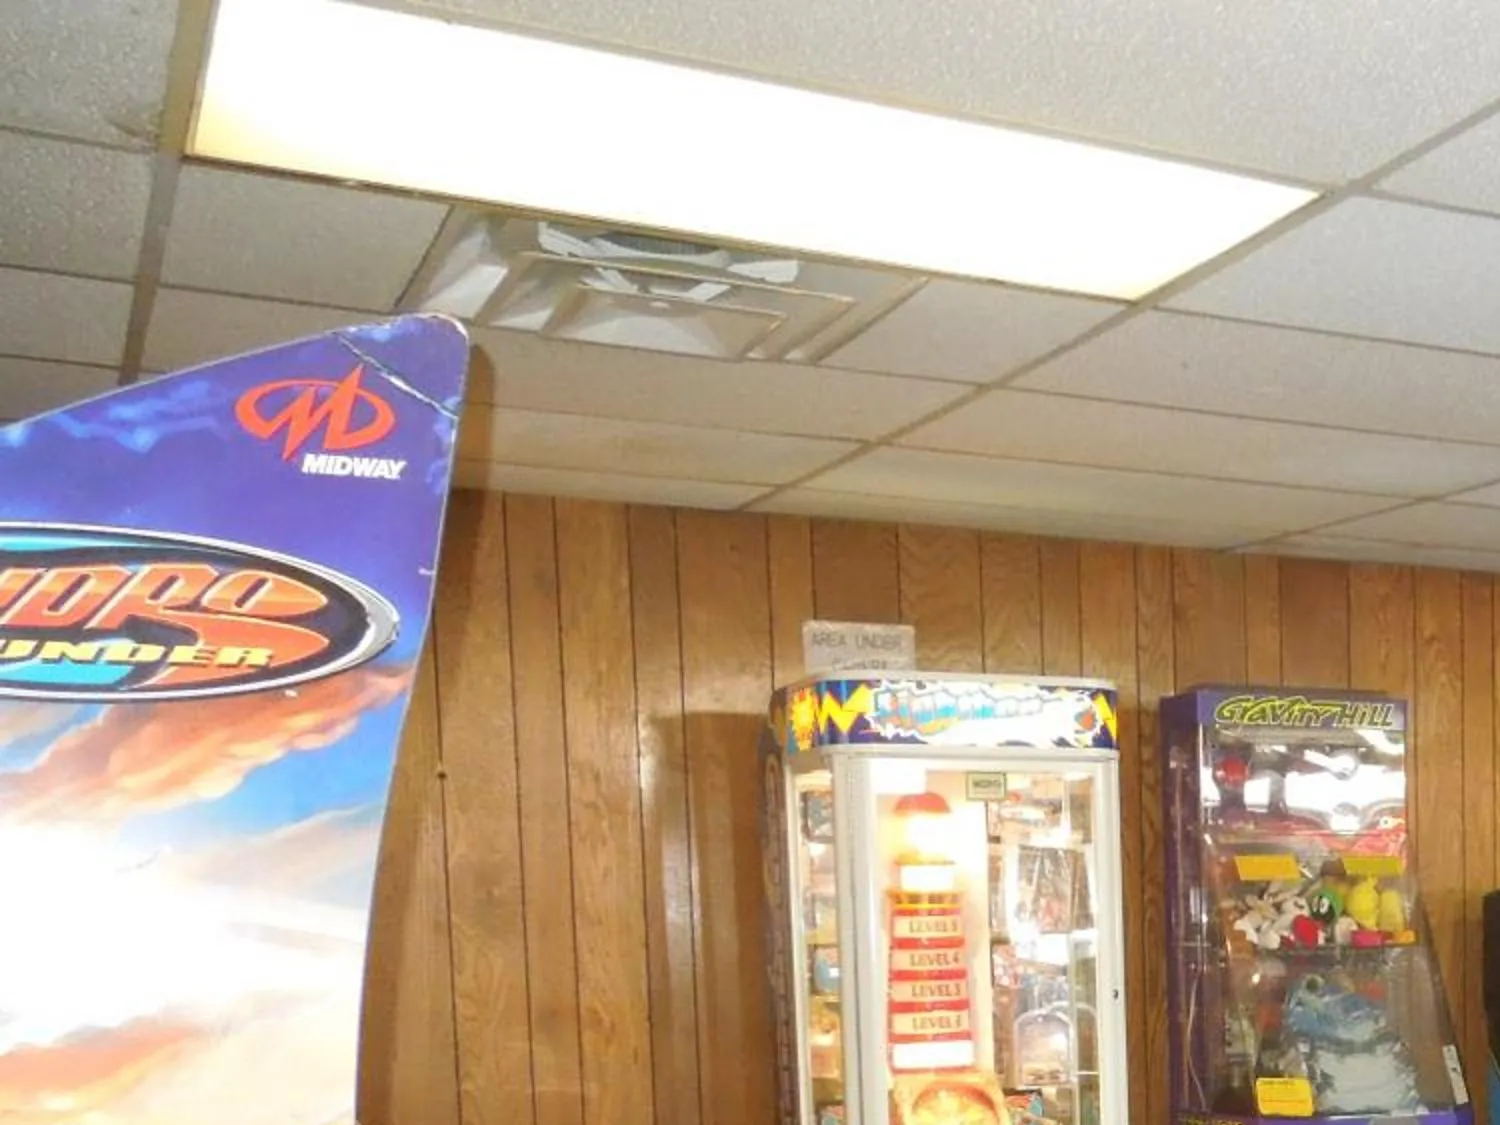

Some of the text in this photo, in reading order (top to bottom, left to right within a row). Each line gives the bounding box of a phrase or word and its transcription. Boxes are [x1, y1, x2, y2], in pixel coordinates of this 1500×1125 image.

[302, 453, 407, 480] MIDWAY
[909, 919, 949, 934] LEVEL
[910, 953, 950, 968] LEVEL
[911, 983, 952, 998] LEVEL
[912, 1015, 952, 1031] LEVEL
